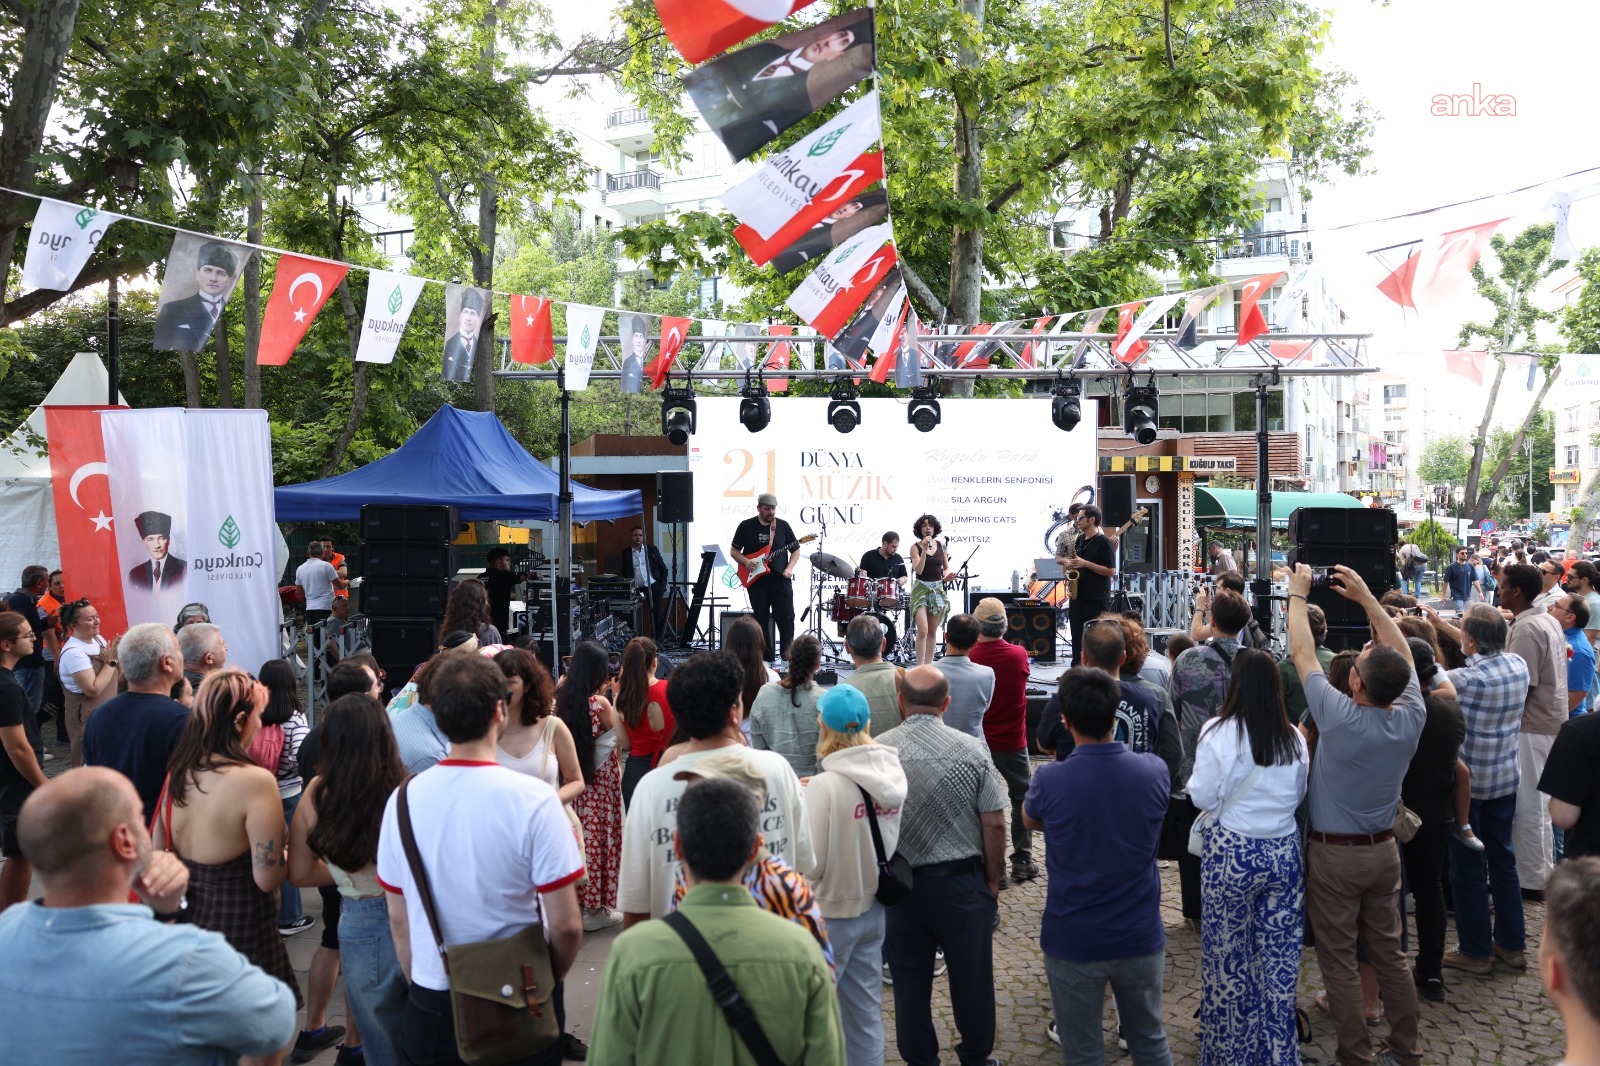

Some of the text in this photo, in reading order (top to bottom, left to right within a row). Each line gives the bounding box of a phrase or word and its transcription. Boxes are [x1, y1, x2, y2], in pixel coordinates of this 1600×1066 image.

[801, 449, 863, 467] DÜNYA
[1190, 458, 1235, 469] KUĞULU TAKSİ
[723, 448, 776, 497] 21
[951, 476, 1002, 484] RENKLERİN
[1004, 475, 1053, 484] SENFONİSİ
[801, 471, 893, 500] MÜZİK
[974, 496, 1007, 504] ARGUN
[721, 504, 787, 514] HAZİN
[800, 503, 863, 525] GÜNÜ
[1182, 486, 1191, 530] KUĞULU
[950, 516, 991, 524] JUMPING
